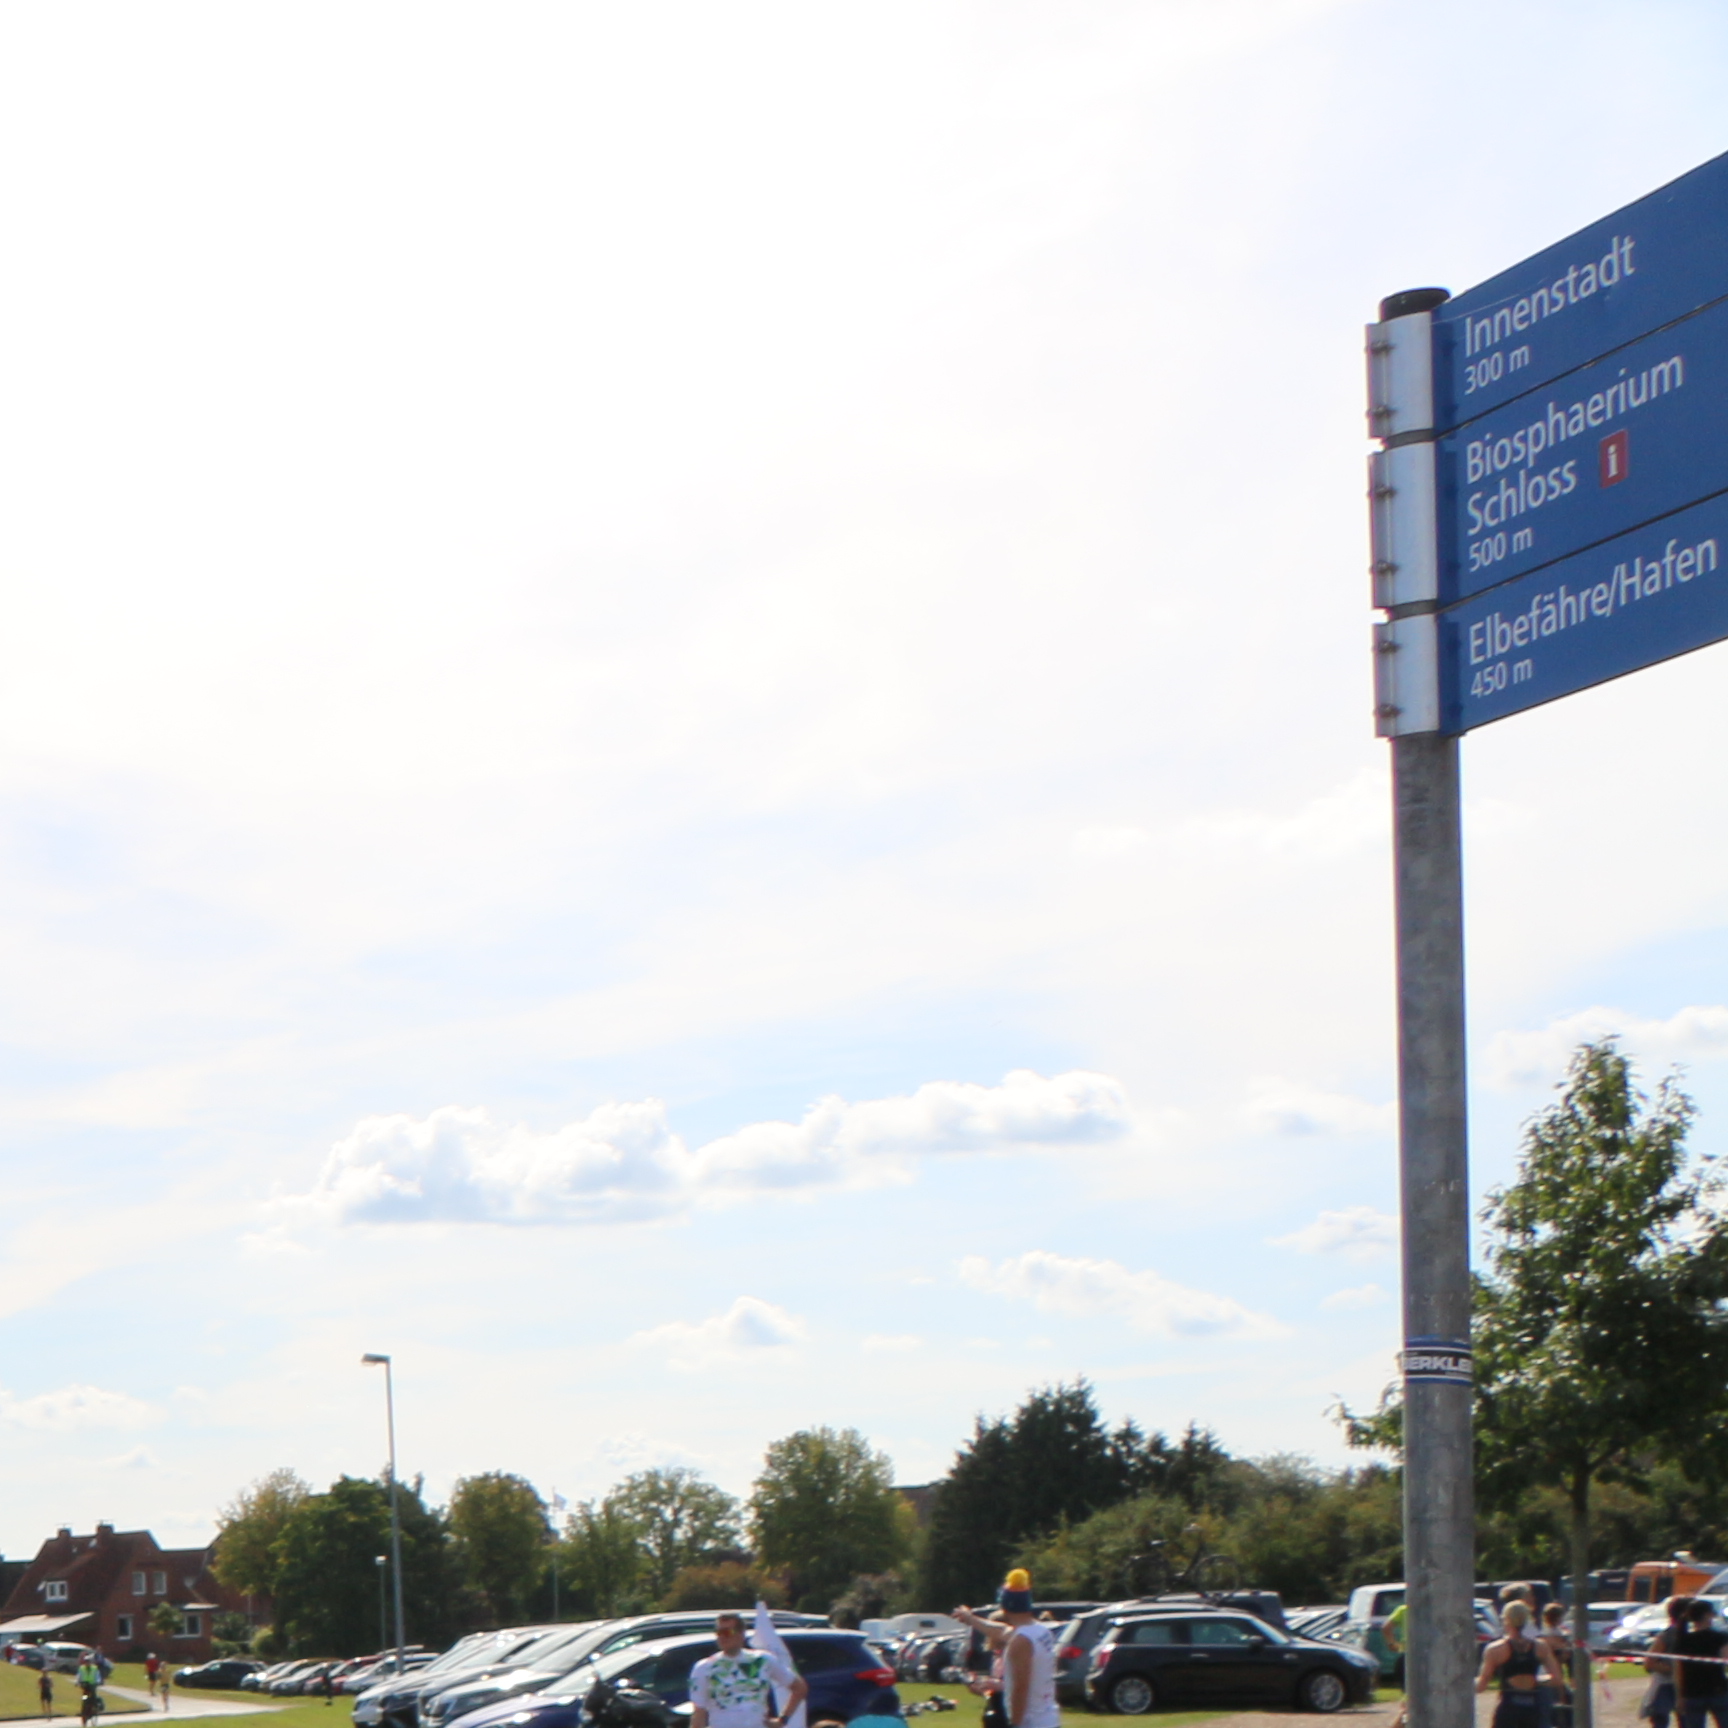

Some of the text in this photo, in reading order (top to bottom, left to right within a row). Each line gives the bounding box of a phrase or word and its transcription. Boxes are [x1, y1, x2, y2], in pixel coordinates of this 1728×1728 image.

[1464, 234, 1636, 358] Innenstadt
[1463, 345, 1530, 396] 300 m
[1466, 355, 1684, 484] Biosphaerium
[1467, 459, 1577, 536] Schloss
[1469, 527, 1533, 572] 500 m
[1469, 538, 1718, 666] Elbefähre/Hafen
[1470, 658, 1533, 698] 450 m
